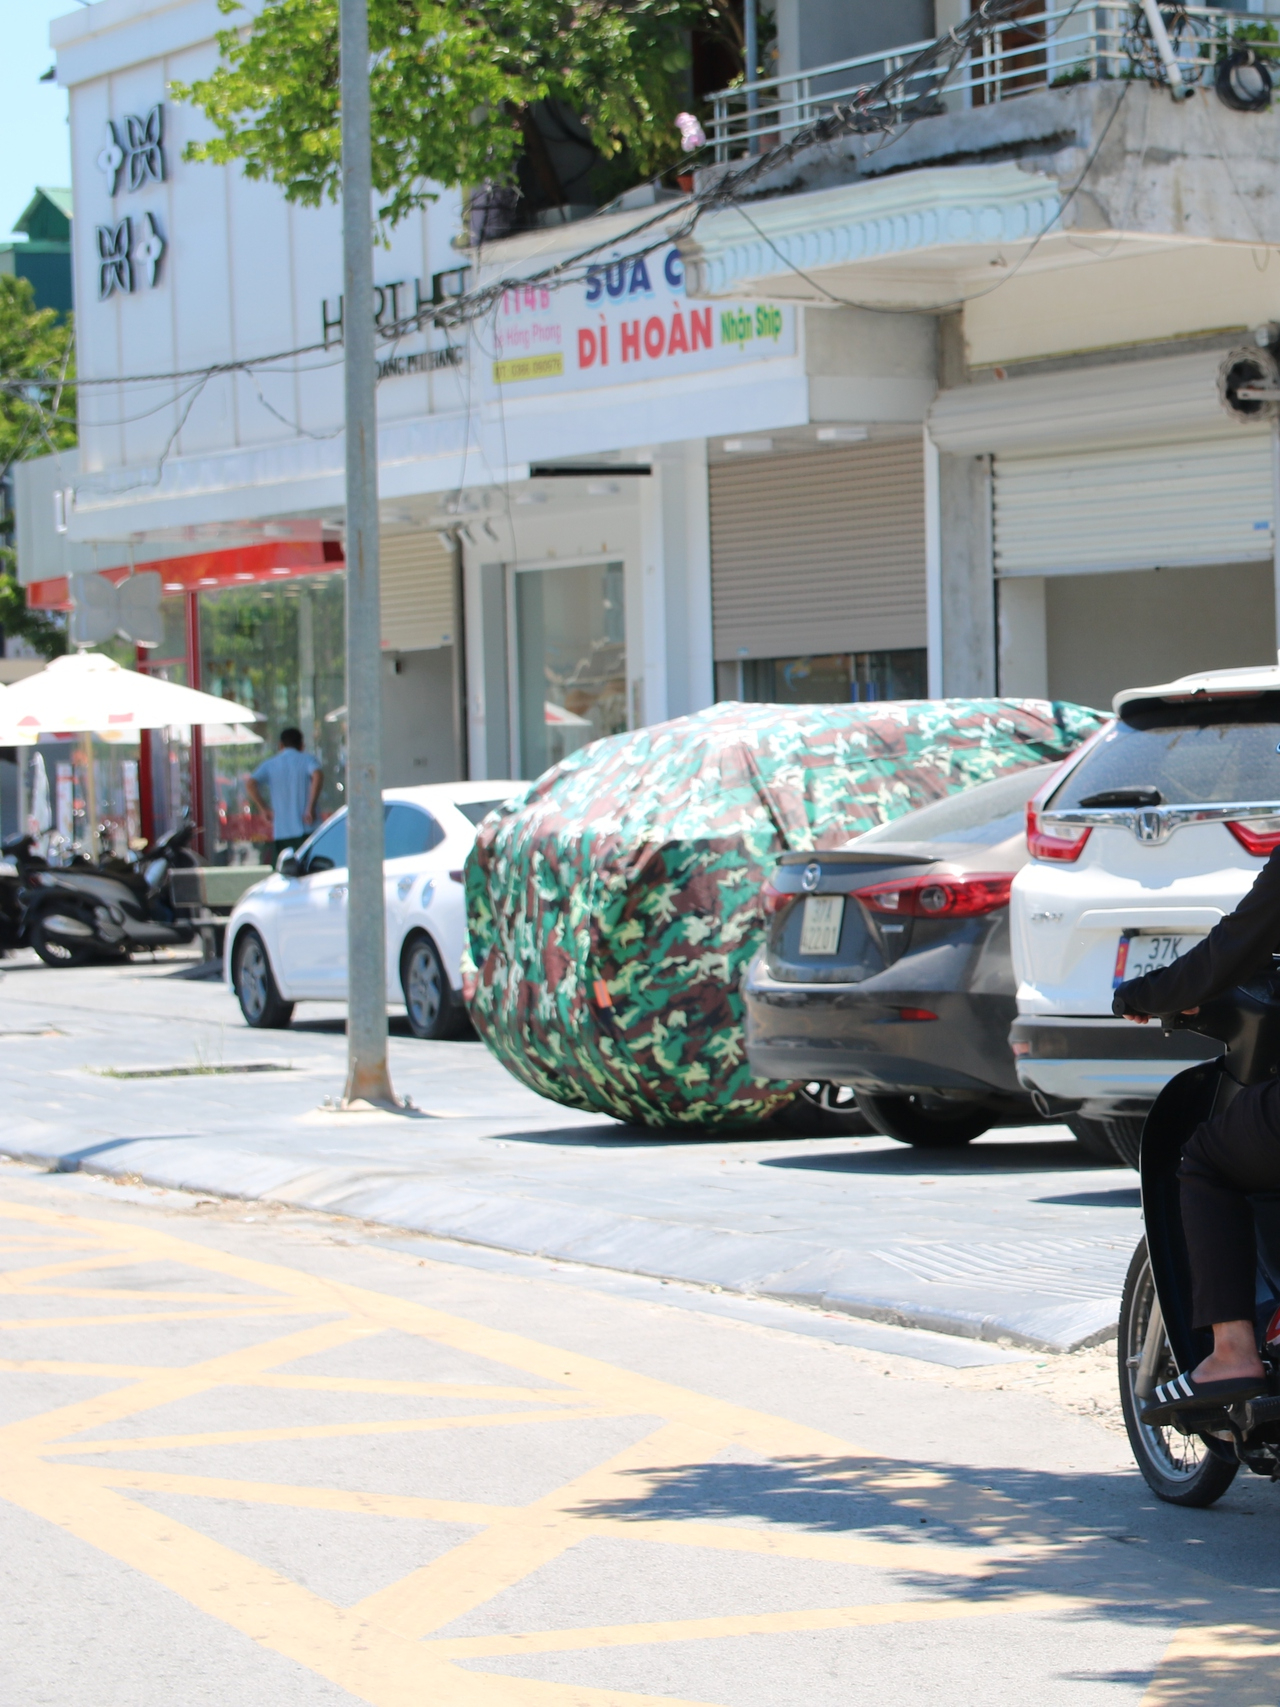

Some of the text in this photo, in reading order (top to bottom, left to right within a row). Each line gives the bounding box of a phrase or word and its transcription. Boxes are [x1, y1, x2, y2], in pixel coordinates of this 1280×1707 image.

[577, 300, 714, 370] DÌ HOÀN
[720, 303, 783, 350] Nhận Ship
[1148, 936, 1182, 960] 37K
